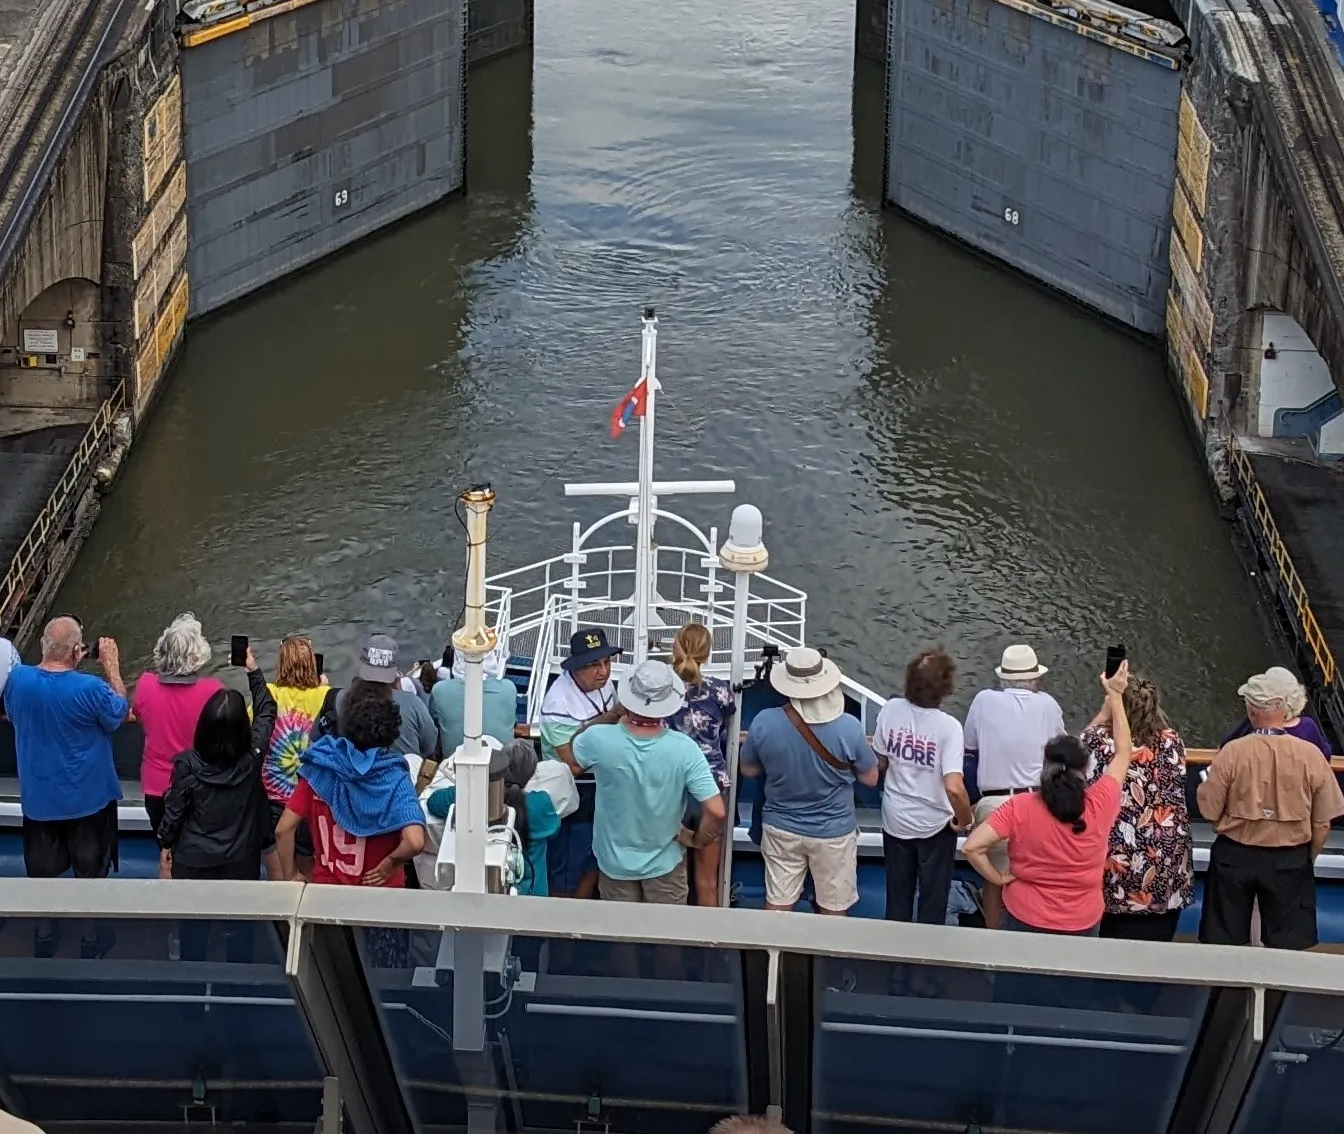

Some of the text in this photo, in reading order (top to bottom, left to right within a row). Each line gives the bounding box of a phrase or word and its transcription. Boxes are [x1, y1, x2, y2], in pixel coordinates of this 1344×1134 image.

[335, 189, 348, 207] 69
[1004, 207, 1019, 225] 68
[886, 736, 936, 769] MORE
[318, 815, 367, 877] 19
